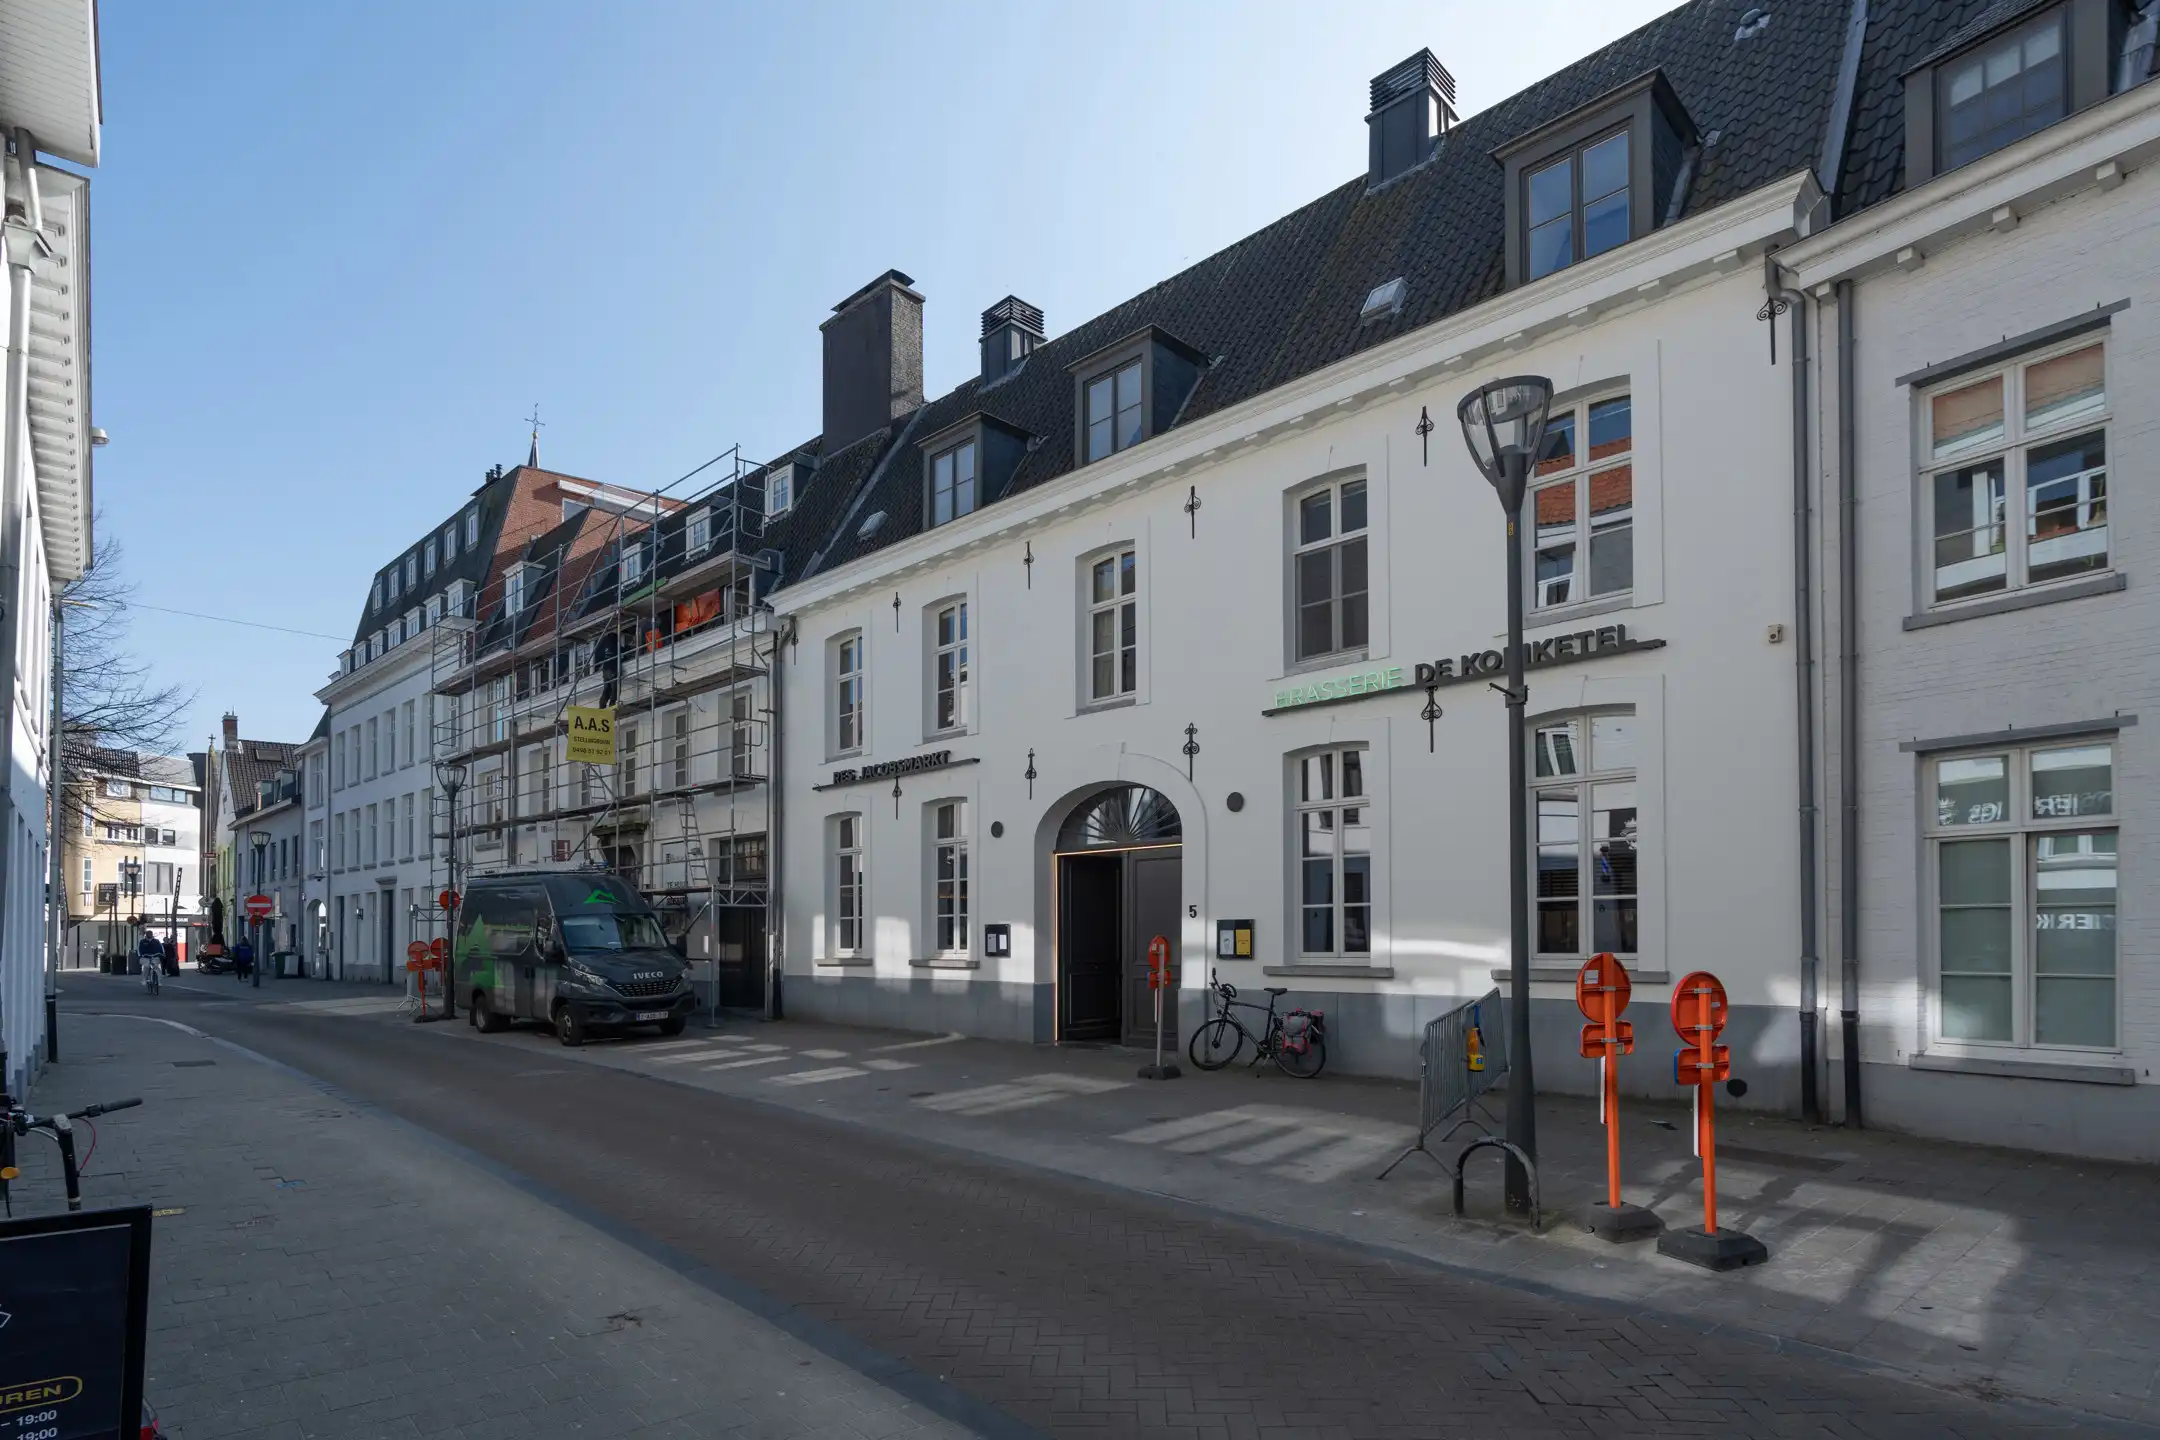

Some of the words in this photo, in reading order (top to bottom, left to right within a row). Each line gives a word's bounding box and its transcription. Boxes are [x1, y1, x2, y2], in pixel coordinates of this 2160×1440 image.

[1275, 666, 1402, 707] BRASSERIE
[1415, 658, 1453, 685] DE
[859, 750, 952, 781] JACOBSMARKT
[1189, 904, 1197, 918] 5
[633, 971, 664, 980] IVECO
[0, 1384, 61, 1405] REN
[16, 1409, 57, 1426] 19:00
[17, 1427, 58, 1440] 19:00
